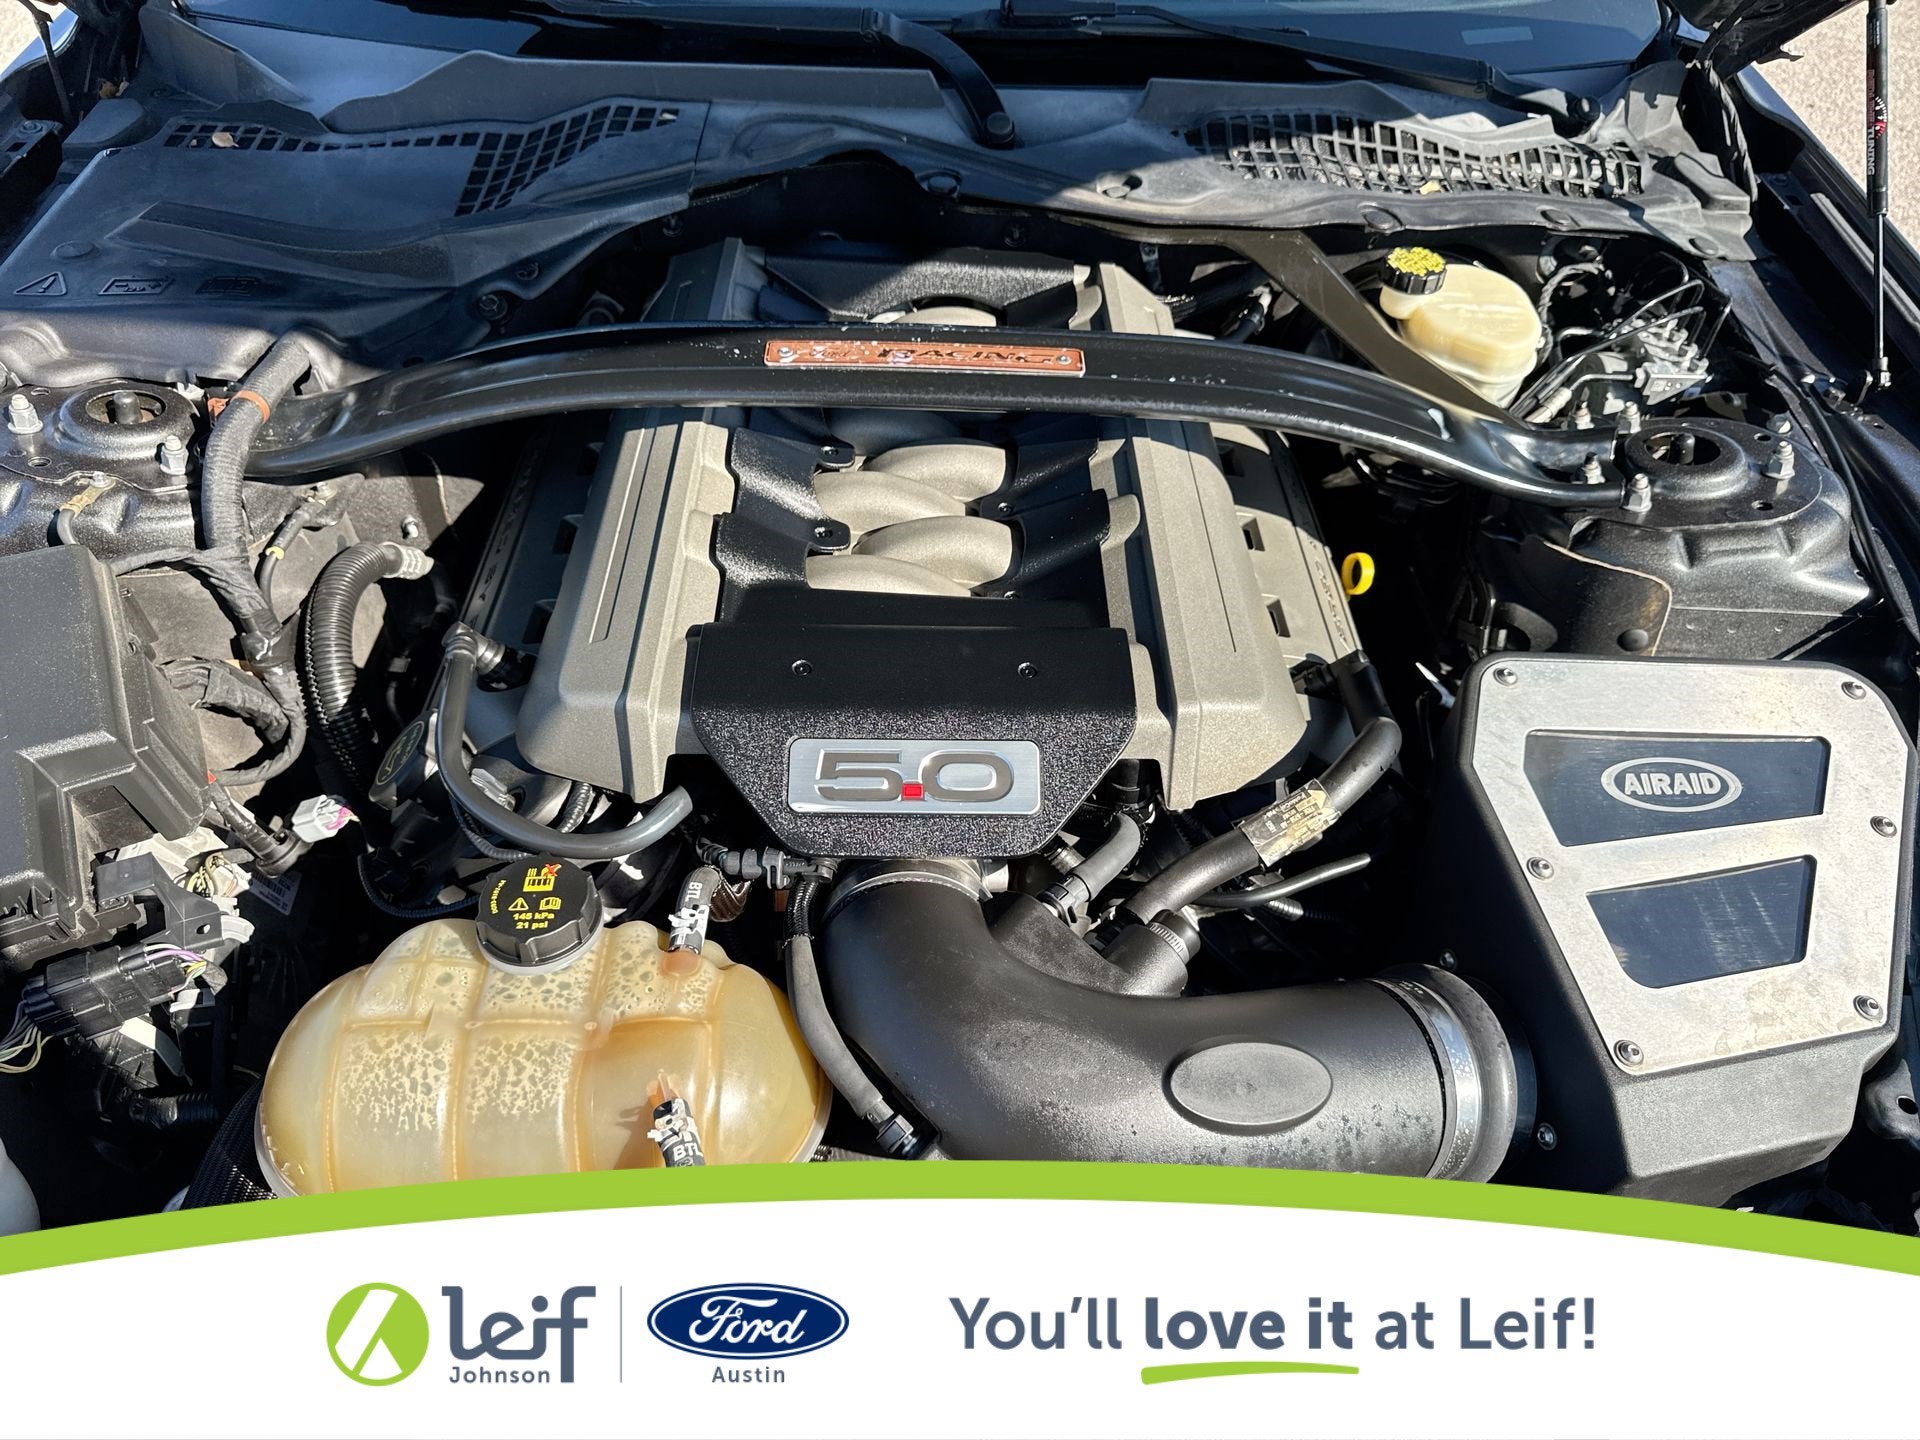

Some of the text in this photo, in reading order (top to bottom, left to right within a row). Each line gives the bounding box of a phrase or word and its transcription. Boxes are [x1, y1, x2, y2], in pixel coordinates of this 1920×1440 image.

[1867, 126, 1875, 176] TUNING
[814, 748, 1015, 803] 5.0
[1624, 772, 1722, 796] AIRAID
[513, 912, 555, 921] 145 kPa
[516, 920, 549, 930] 21 psi
